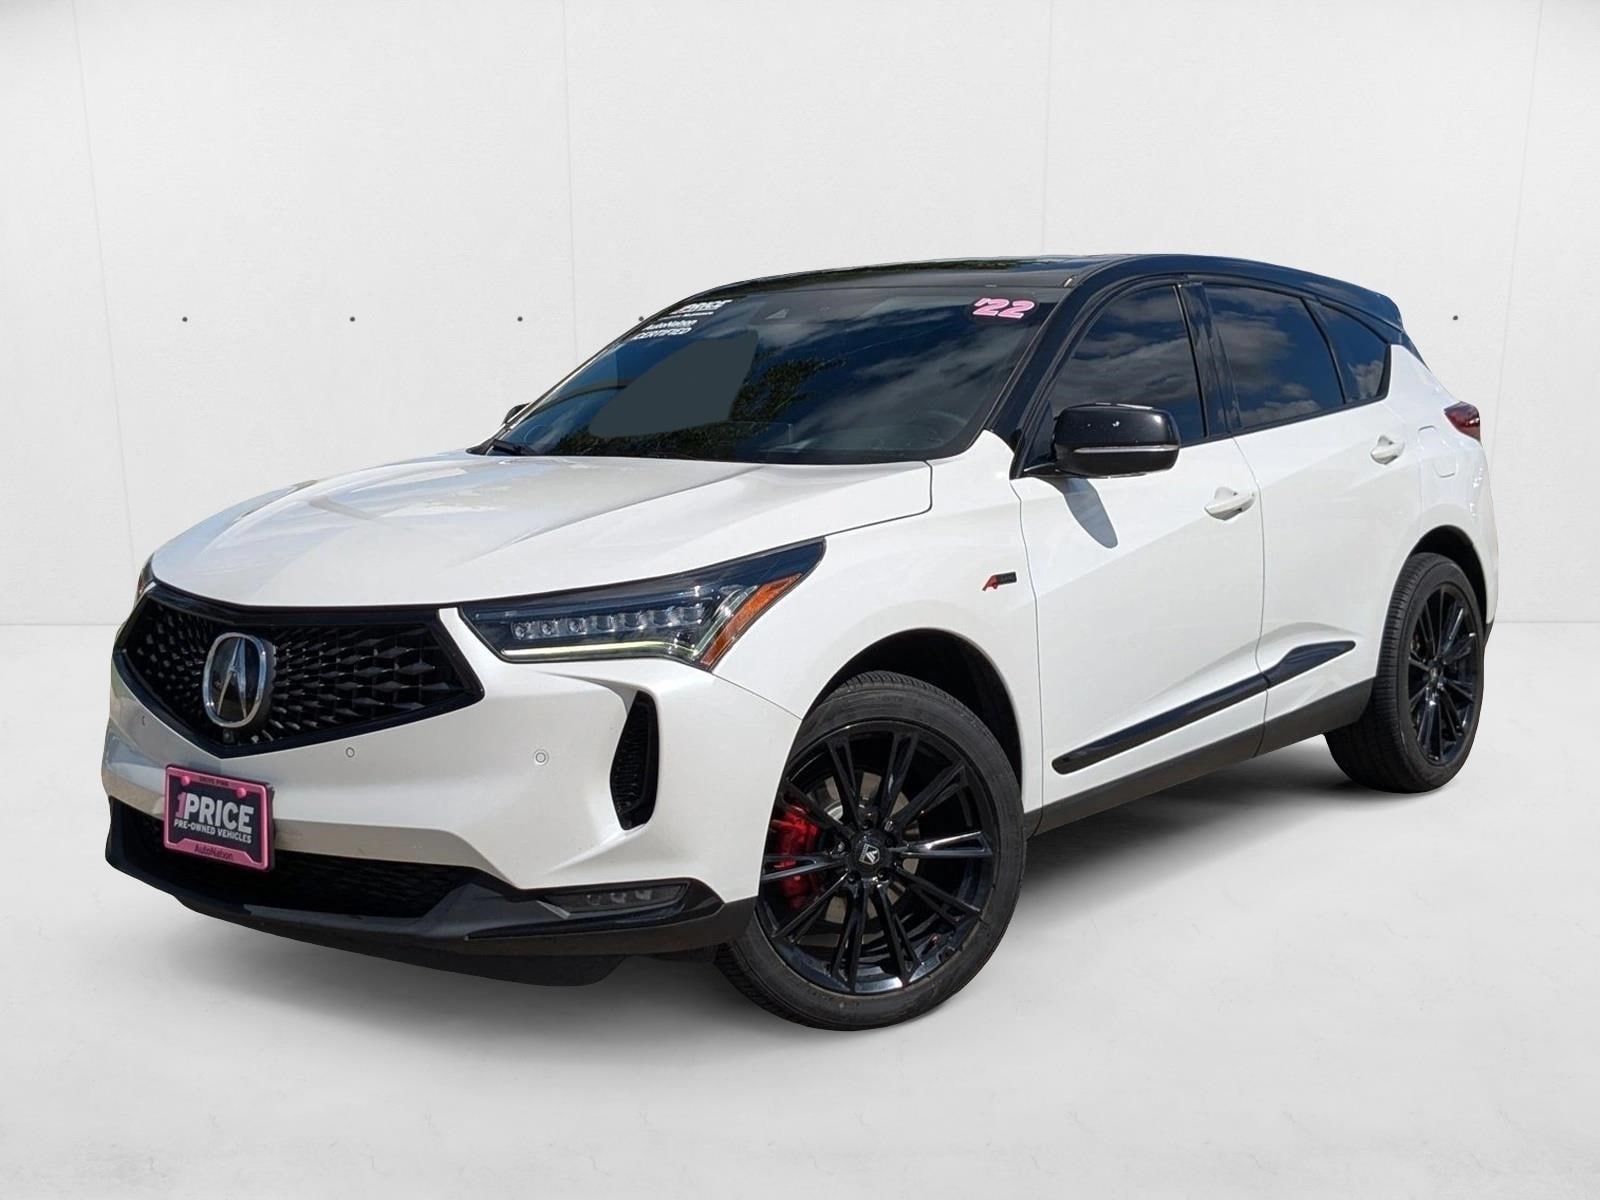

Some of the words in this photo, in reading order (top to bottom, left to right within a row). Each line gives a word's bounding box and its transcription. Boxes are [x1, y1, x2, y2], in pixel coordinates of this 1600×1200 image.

[174, 818, 216, 836] PRE-OWNED
[217, 828, 252, 844] VEHICLES
[194, 843, 233, 861] AutoNation
